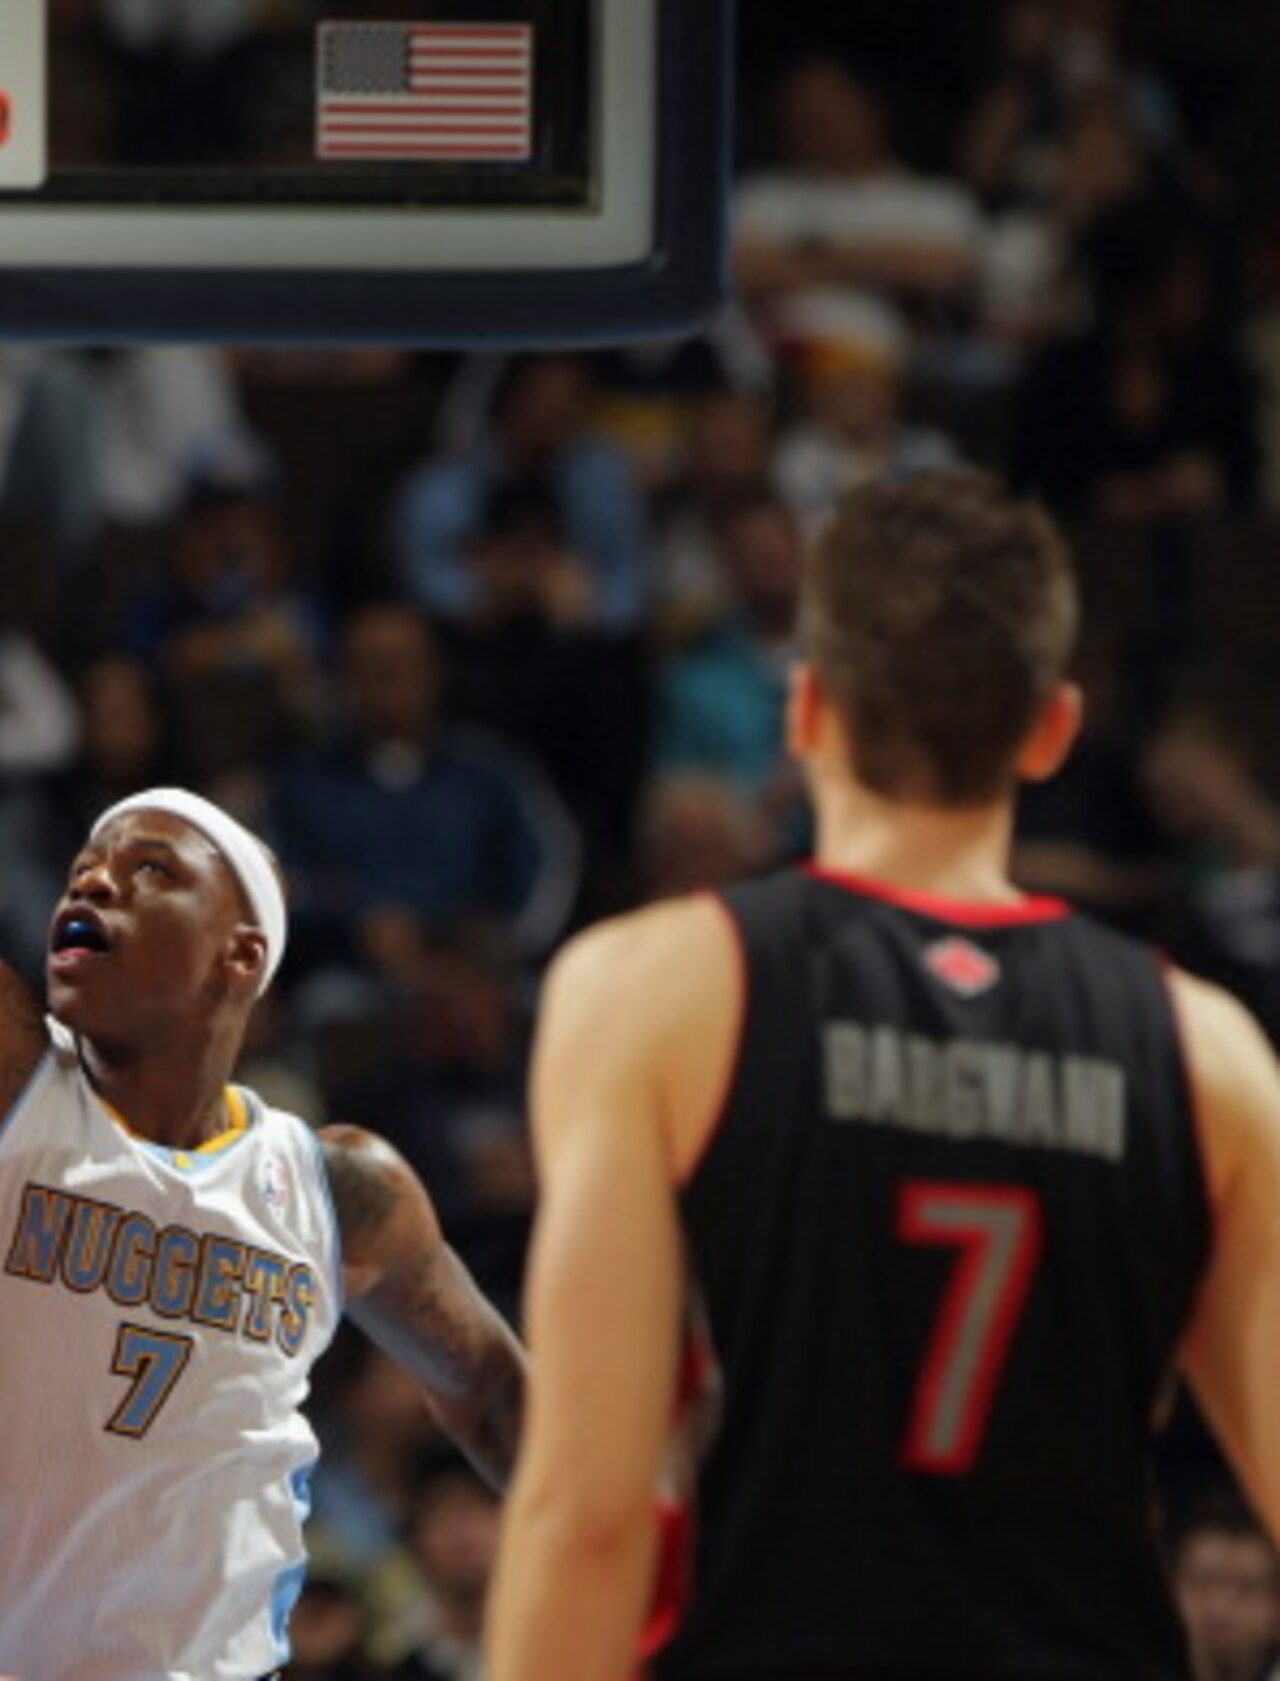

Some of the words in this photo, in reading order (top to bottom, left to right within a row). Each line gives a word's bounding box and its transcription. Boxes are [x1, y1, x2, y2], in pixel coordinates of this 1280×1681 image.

[4, 1181, 314, 1358] NUGGETS
[893, 1178, 1042, 1477] 7
[103, 1321, 196, 1440] 7
